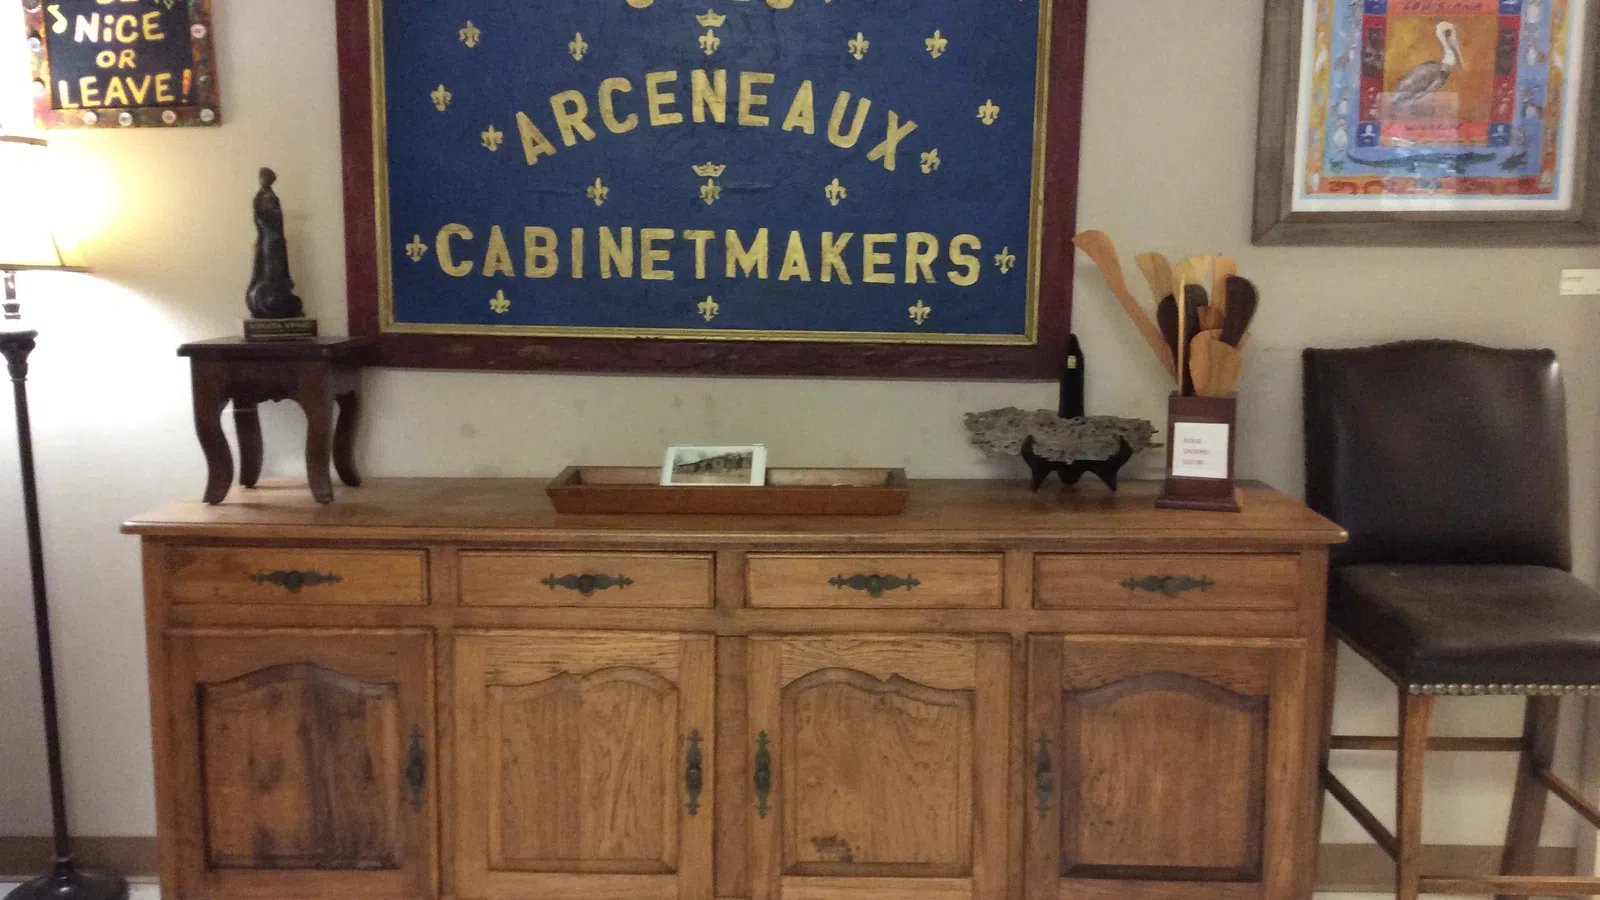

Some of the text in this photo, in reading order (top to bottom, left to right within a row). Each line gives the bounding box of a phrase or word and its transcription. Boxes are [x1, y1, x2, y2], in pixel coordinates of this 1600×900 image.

[96, 49, 136, 69] OR
[58, 68, 192, 109] LEAVE!
[516, 69, 918, 171] ARCENEAUX
[436, 223, 982, 286] CABINETMAKERS
